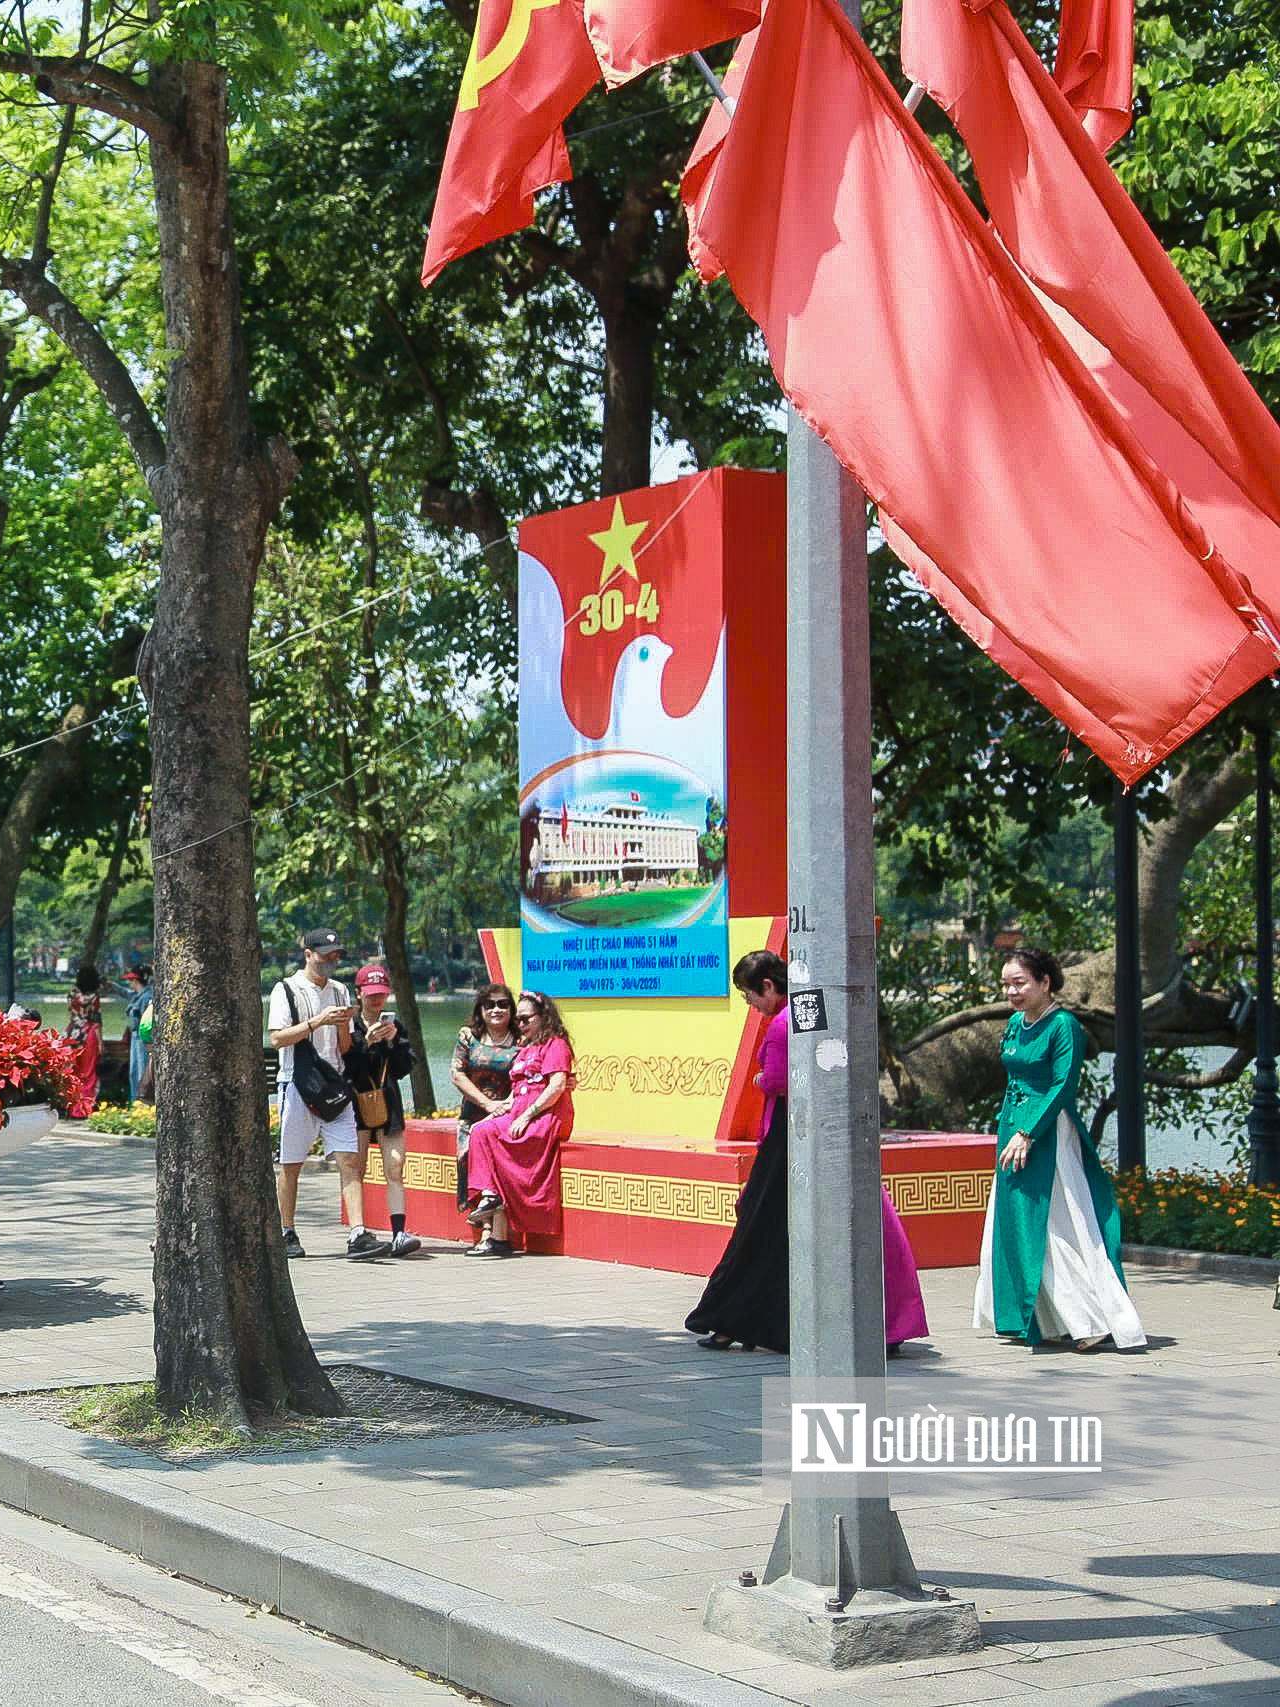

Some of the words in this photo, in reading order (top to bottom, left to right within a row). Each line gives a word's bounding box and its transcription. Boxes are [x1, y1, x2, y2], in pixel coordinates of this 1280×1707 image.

[579, 582, 660, 636] 30-4
[585, 935, 600, 952] LIỆT
[648, 935, 657, 949] 51
[659, 932, 678, 949] NĂM
[527, 957, 545, 972] NGÀY
[697, 951, 720, 968] NƯỚC
